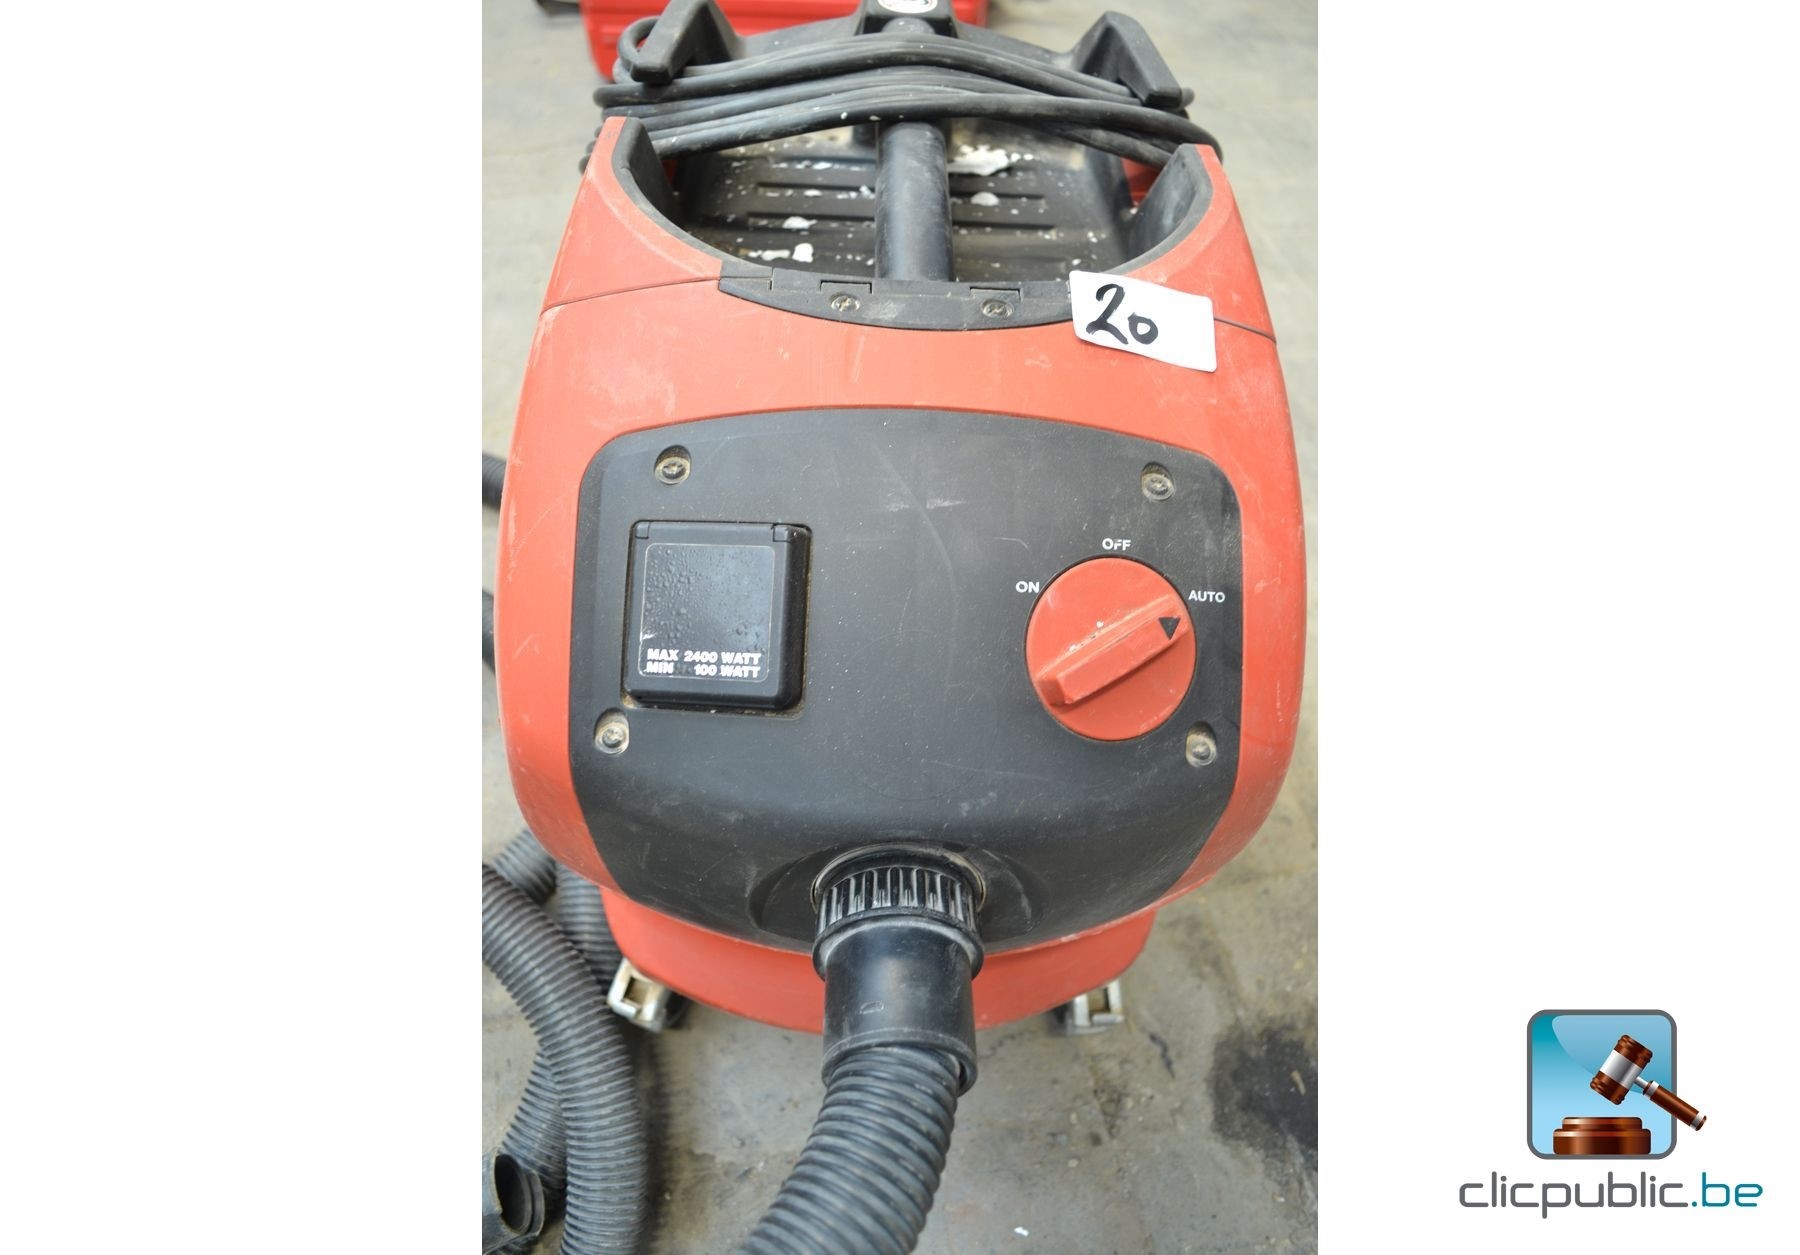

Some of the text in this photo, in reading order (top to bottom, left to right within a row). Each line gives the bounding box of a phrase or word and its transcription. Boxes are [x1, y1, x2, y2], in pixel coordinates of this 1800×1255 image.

[1086, 283, 1158, 344] 20
[1102, 538, 1131, 550] OFF
[1016, 581, 1039, 593] ON
[1188, 591, 1226, 603] AUTO
[647, 649, 762, 665] MAX 2400 WATT
[646, 662, 761, 678] MIN 100 WATT
